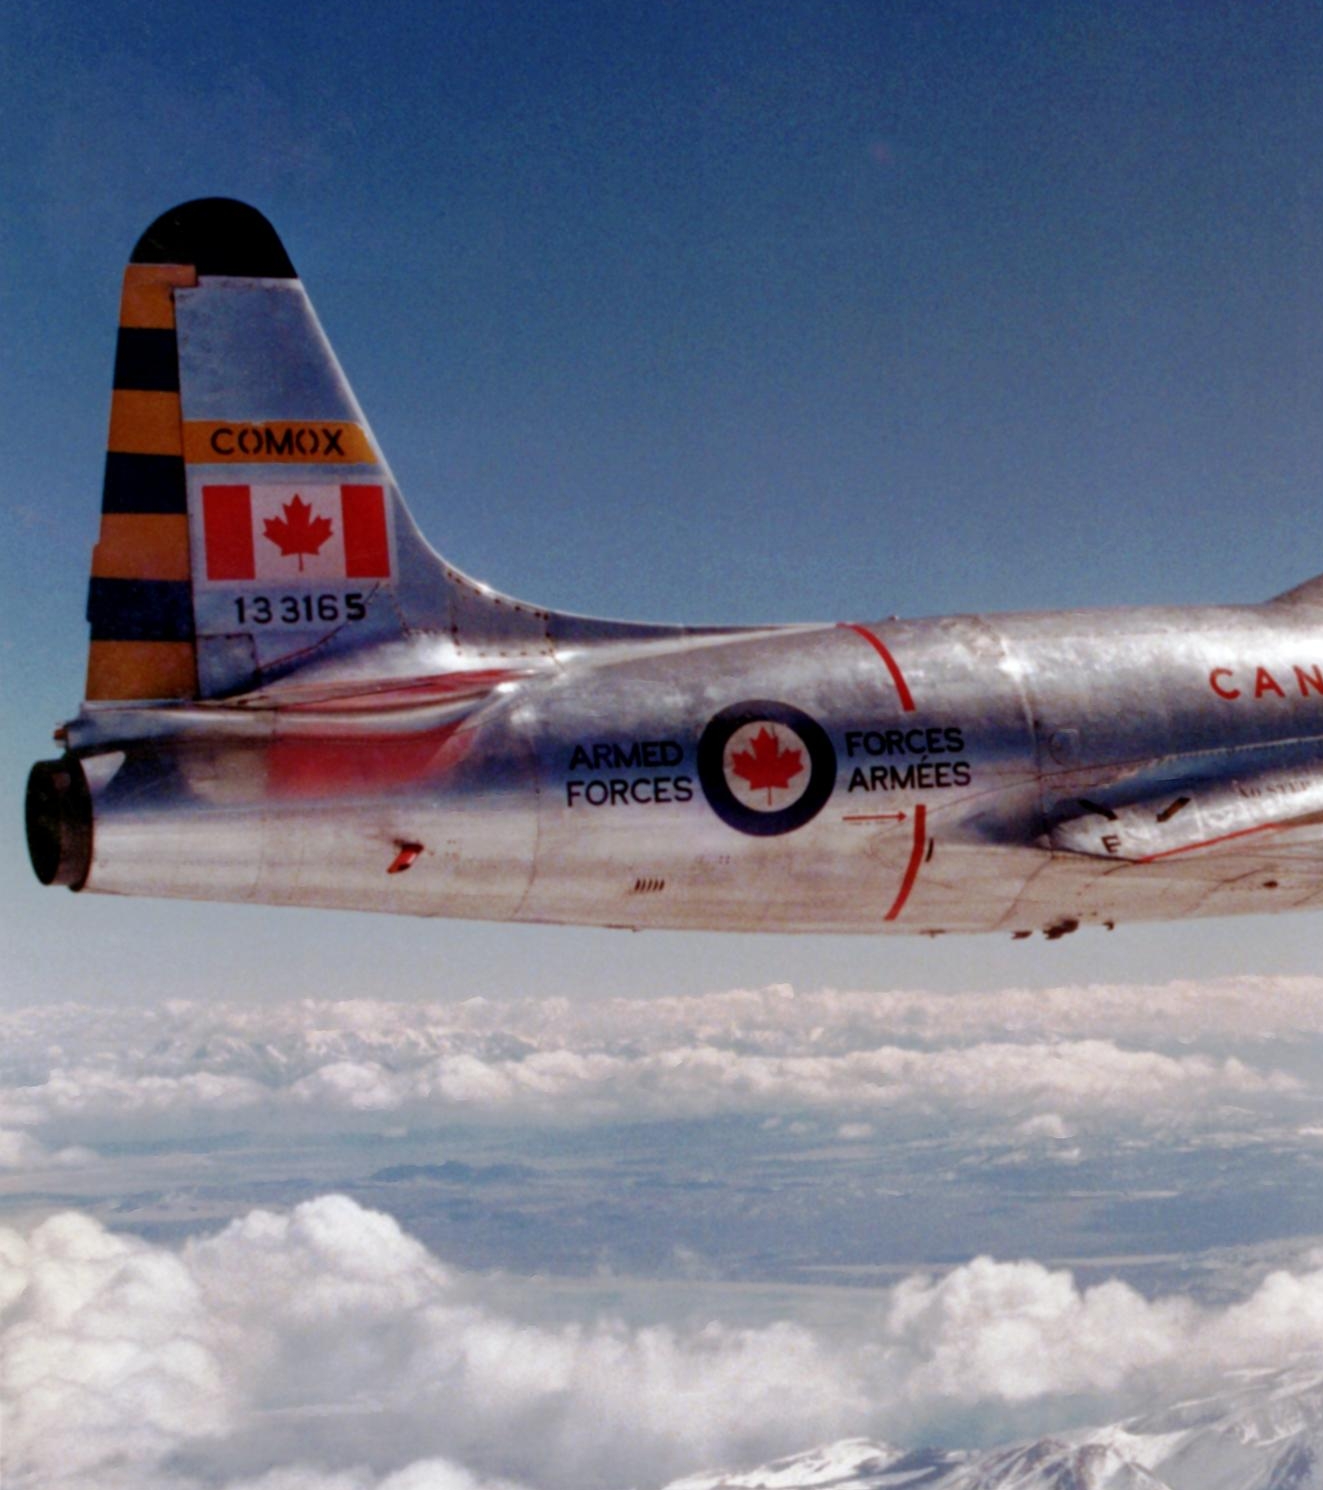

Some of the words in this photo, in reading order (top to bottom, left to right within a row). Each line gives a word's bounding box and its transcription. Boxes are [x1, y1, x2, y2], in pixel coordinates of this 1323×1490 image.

[210, 427, 345, 456] COMOX
[234, 593, 367, 624] 133165
[568, 741, 684, 771] ARMED
[845, 727, 965, 757] FORCES
[848, 755, 971, 793] ARMÉES
[566, 776, 694, 808] FORCES
